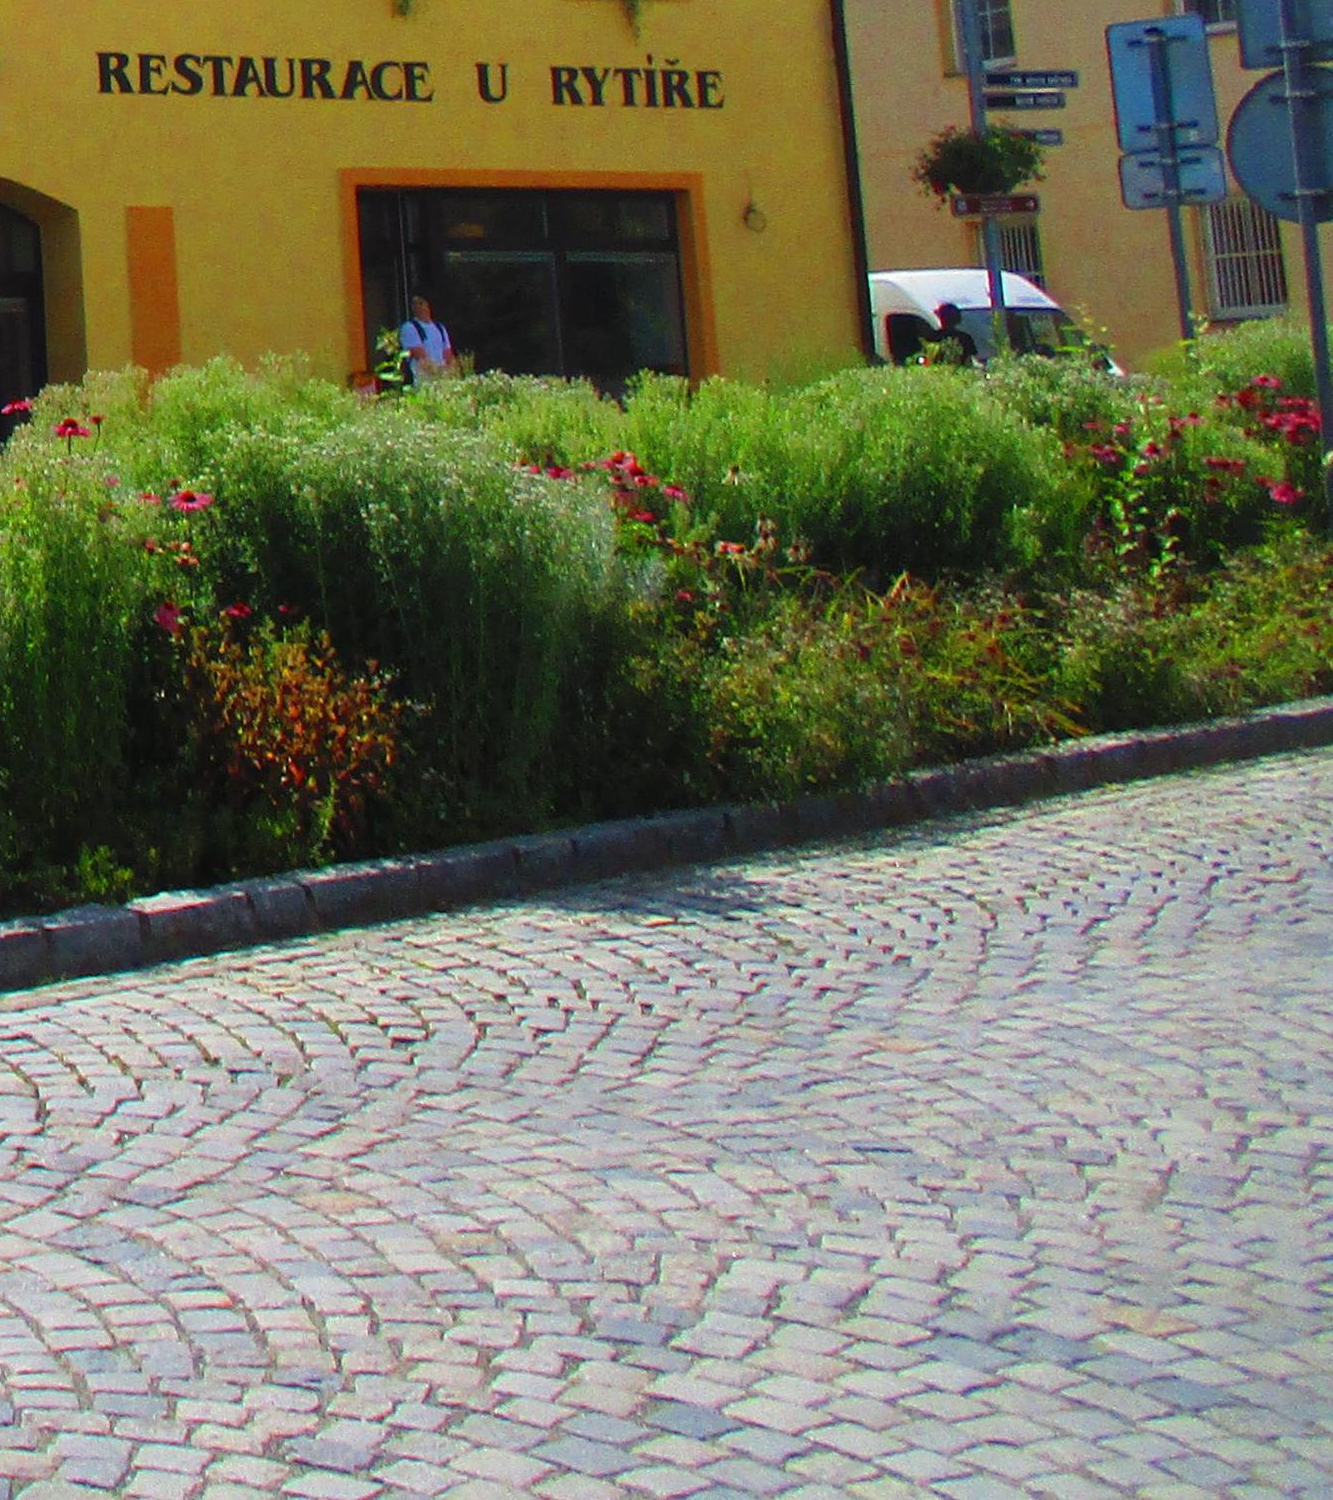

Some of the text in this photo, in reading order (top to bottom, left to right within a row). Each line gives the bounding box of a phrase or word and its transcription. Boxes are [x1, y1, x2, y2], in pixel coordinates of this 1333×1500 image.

[96, 51, 726, 110] RESTAURACE U RYTÍŘE
